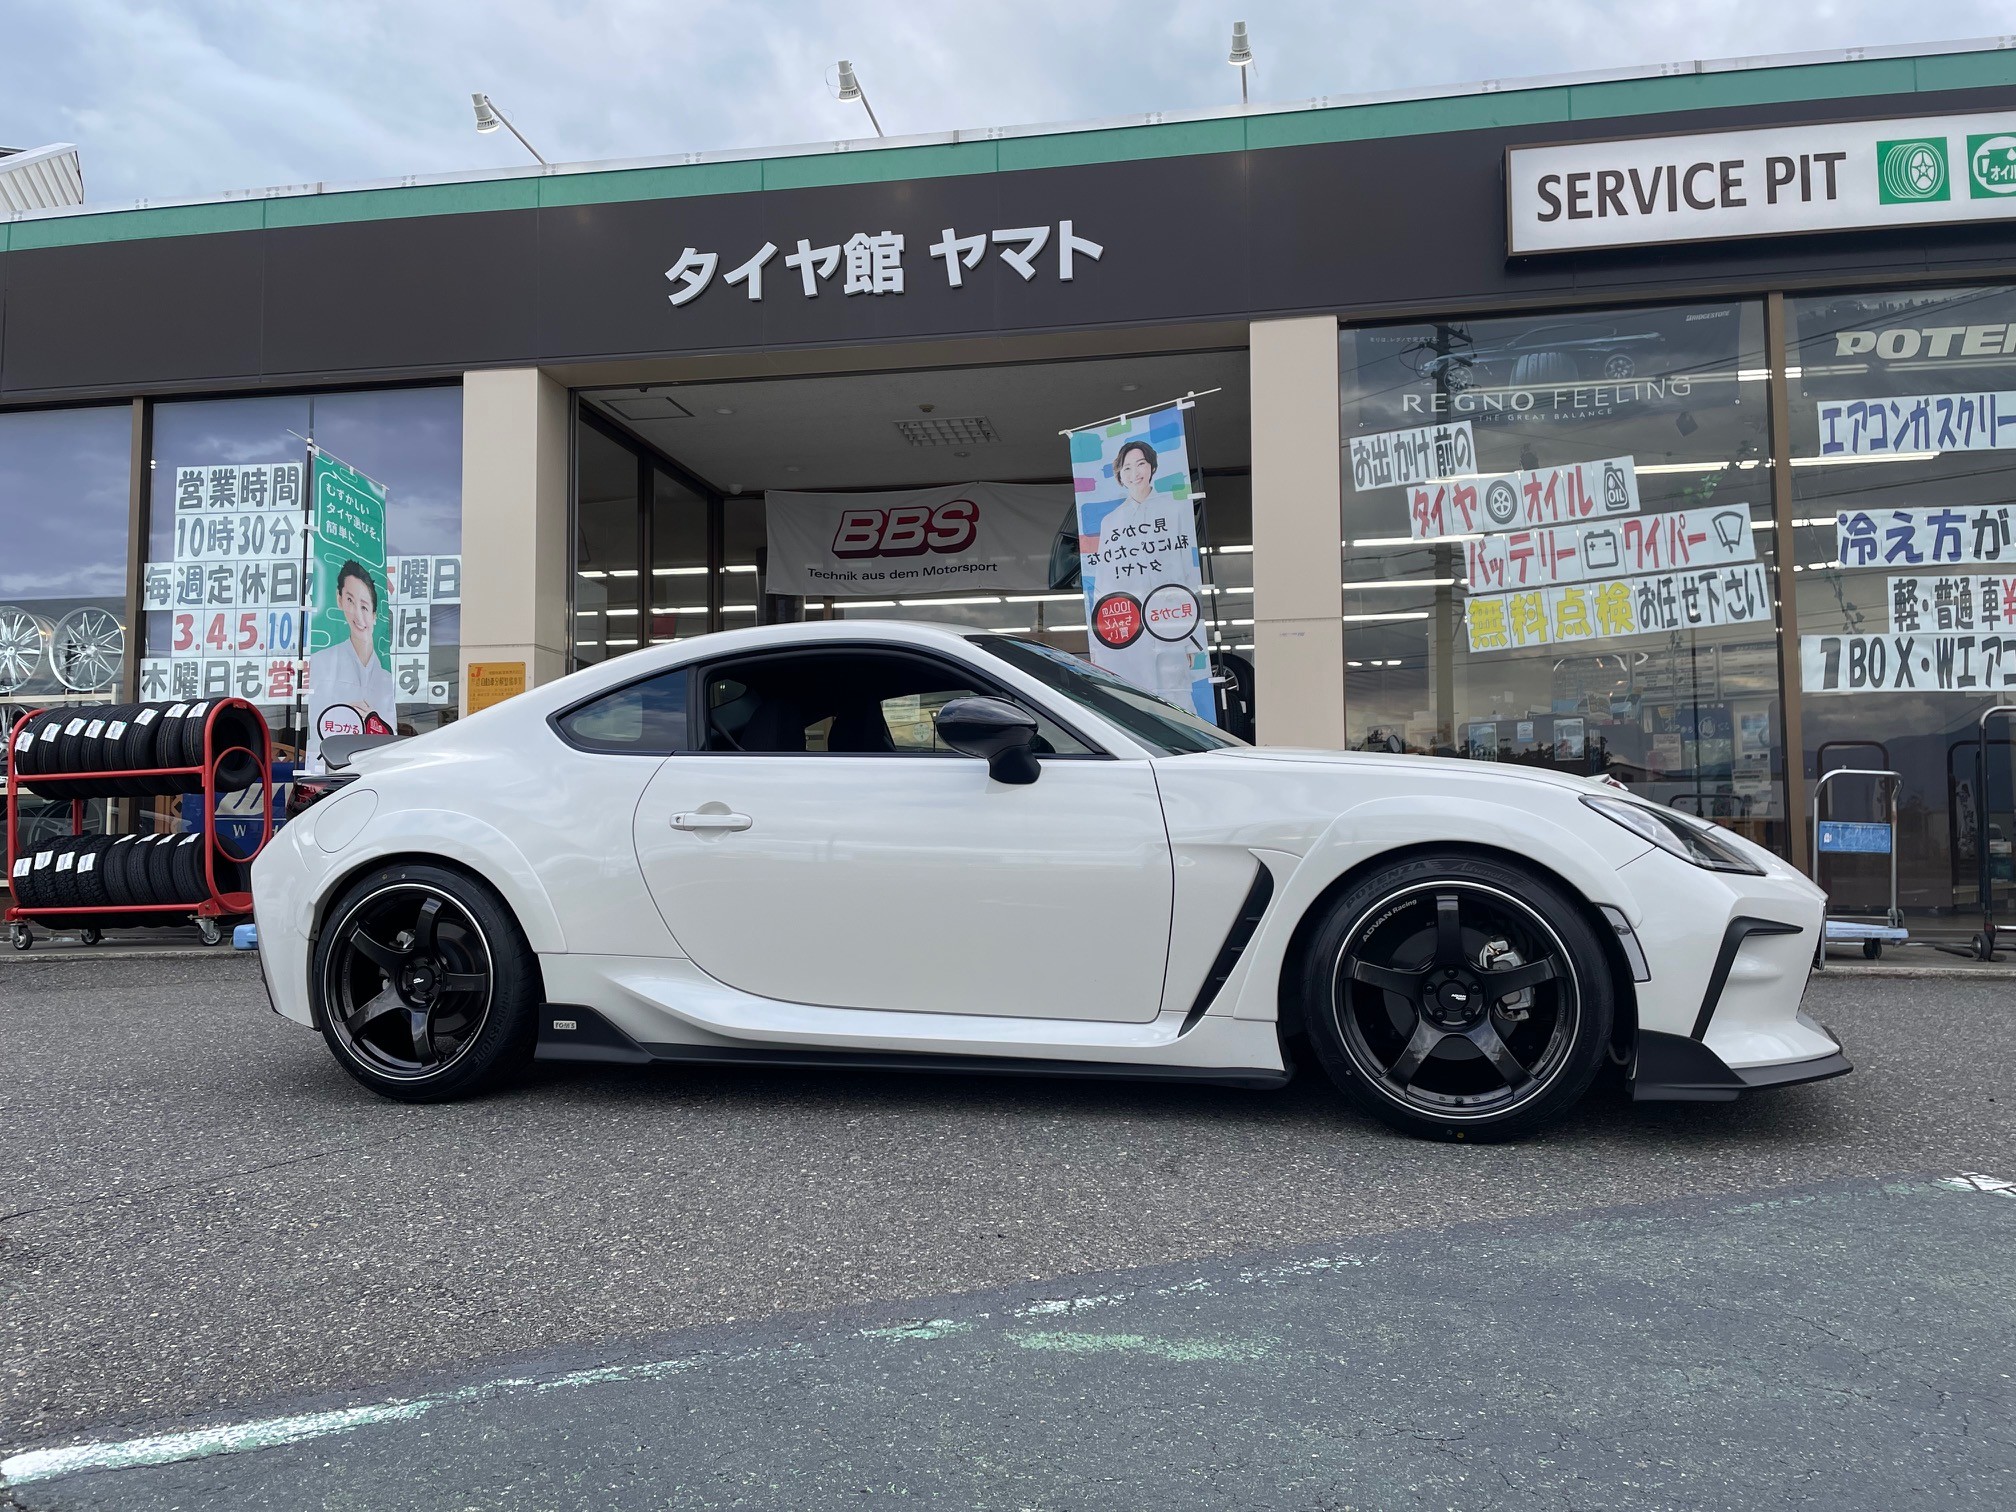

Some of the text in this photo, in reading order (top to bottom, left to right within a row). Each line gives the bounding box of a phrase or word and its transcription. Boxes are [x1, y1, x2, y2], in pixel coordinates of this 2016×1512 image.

[1537, 151, 1847, 222] SERVICE PIT
[664, 219, 1104, 307] タイヤ館 ヤマト
[1403, 376, 1692, 414] REGNO FEELING
[1478, 407, 1613, 422] THE GREAT BALANCE
[1353, 426, 1472, 488] お出かけ前の
[177, 466, 300, 510] 営業時間
[325, 482, 370, 515] むずかしい
[1412, 465, 1626, 538] タイヤ オイル OIL
[831, 499, 980, 559] BBS
[1469, 514, 1707, 589] バッテリー ワイパー
[1838, 507, 2011, 566] 冷え方が
[807, 562, 998, 581] Technik aus dem Motorsport
[1470, 567, 1766, 648] 無料点検お任せ下さい
[1362, 899, 1418, 943] ADVAN Racing
